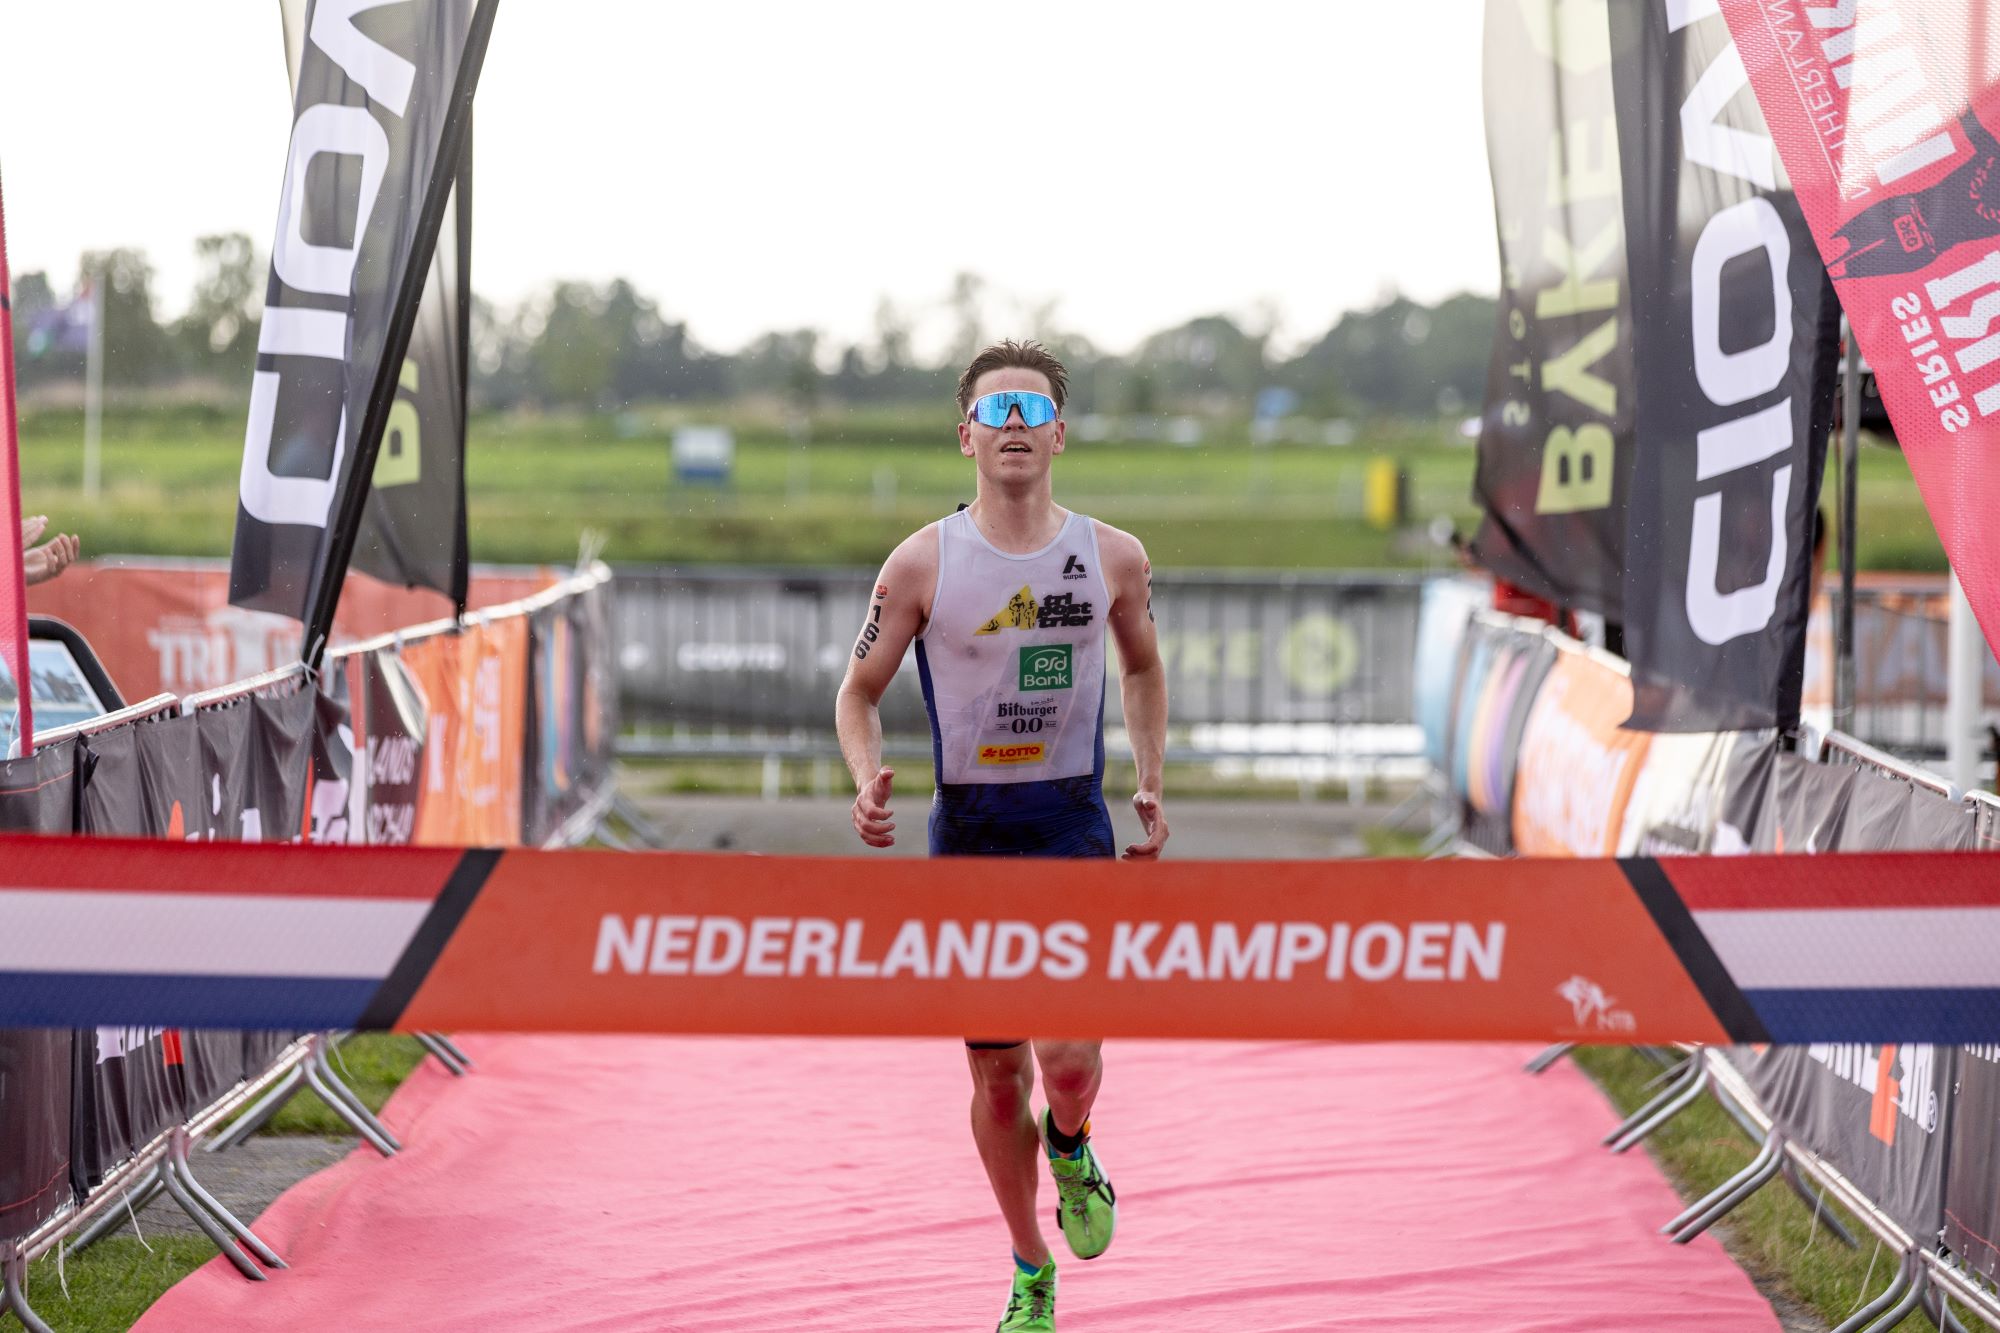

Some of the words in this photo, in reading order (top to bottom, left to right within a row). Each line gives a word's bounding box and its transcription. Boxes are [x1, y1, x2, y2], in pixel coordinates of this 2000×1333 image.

[854, 604, 882, 660] 166
[1023, 672, 1068, 687] Bank
[997, 702, 1058, 718] Bitburger
[1011, 717, 1043, 734] 0.0
[999, 746, 1041, 758] LOTTO
[593, 914, 1089, 981] NEDERLANDS
[1107, 922, 1506, 981] KAMPIOEN
